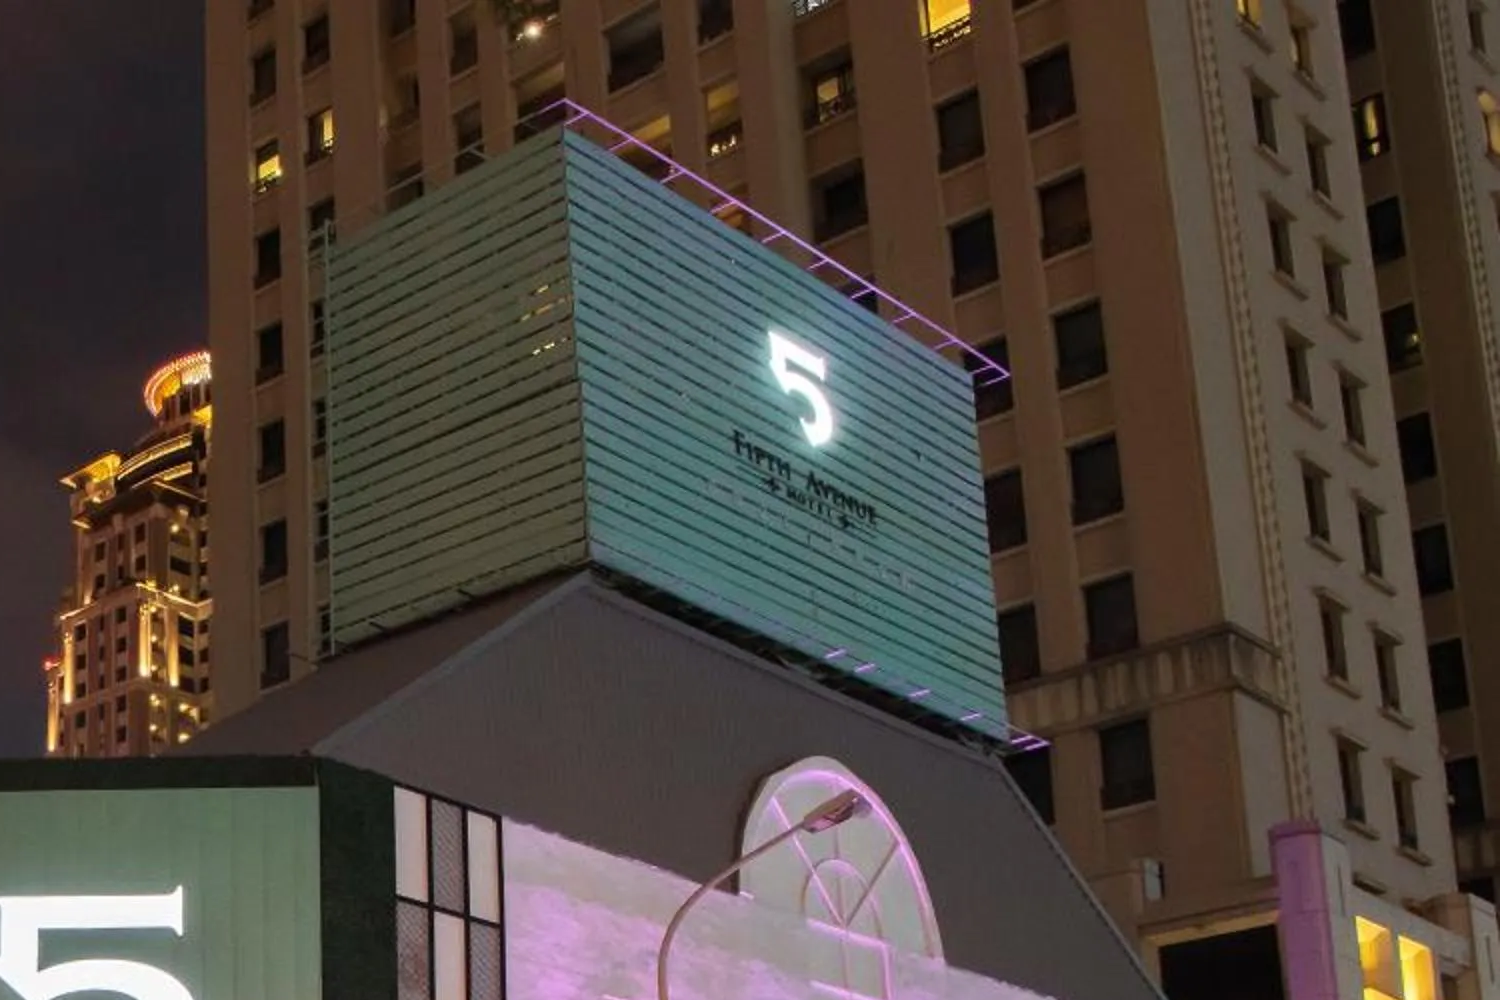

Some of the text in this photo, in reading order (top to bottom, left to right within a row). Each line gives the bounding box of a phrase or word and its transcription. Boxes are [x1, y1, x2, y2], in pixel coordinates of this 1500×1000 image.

[767, 330, 833, 447] 5
[732, 428, 877, 526] FIFTH AVENUE
